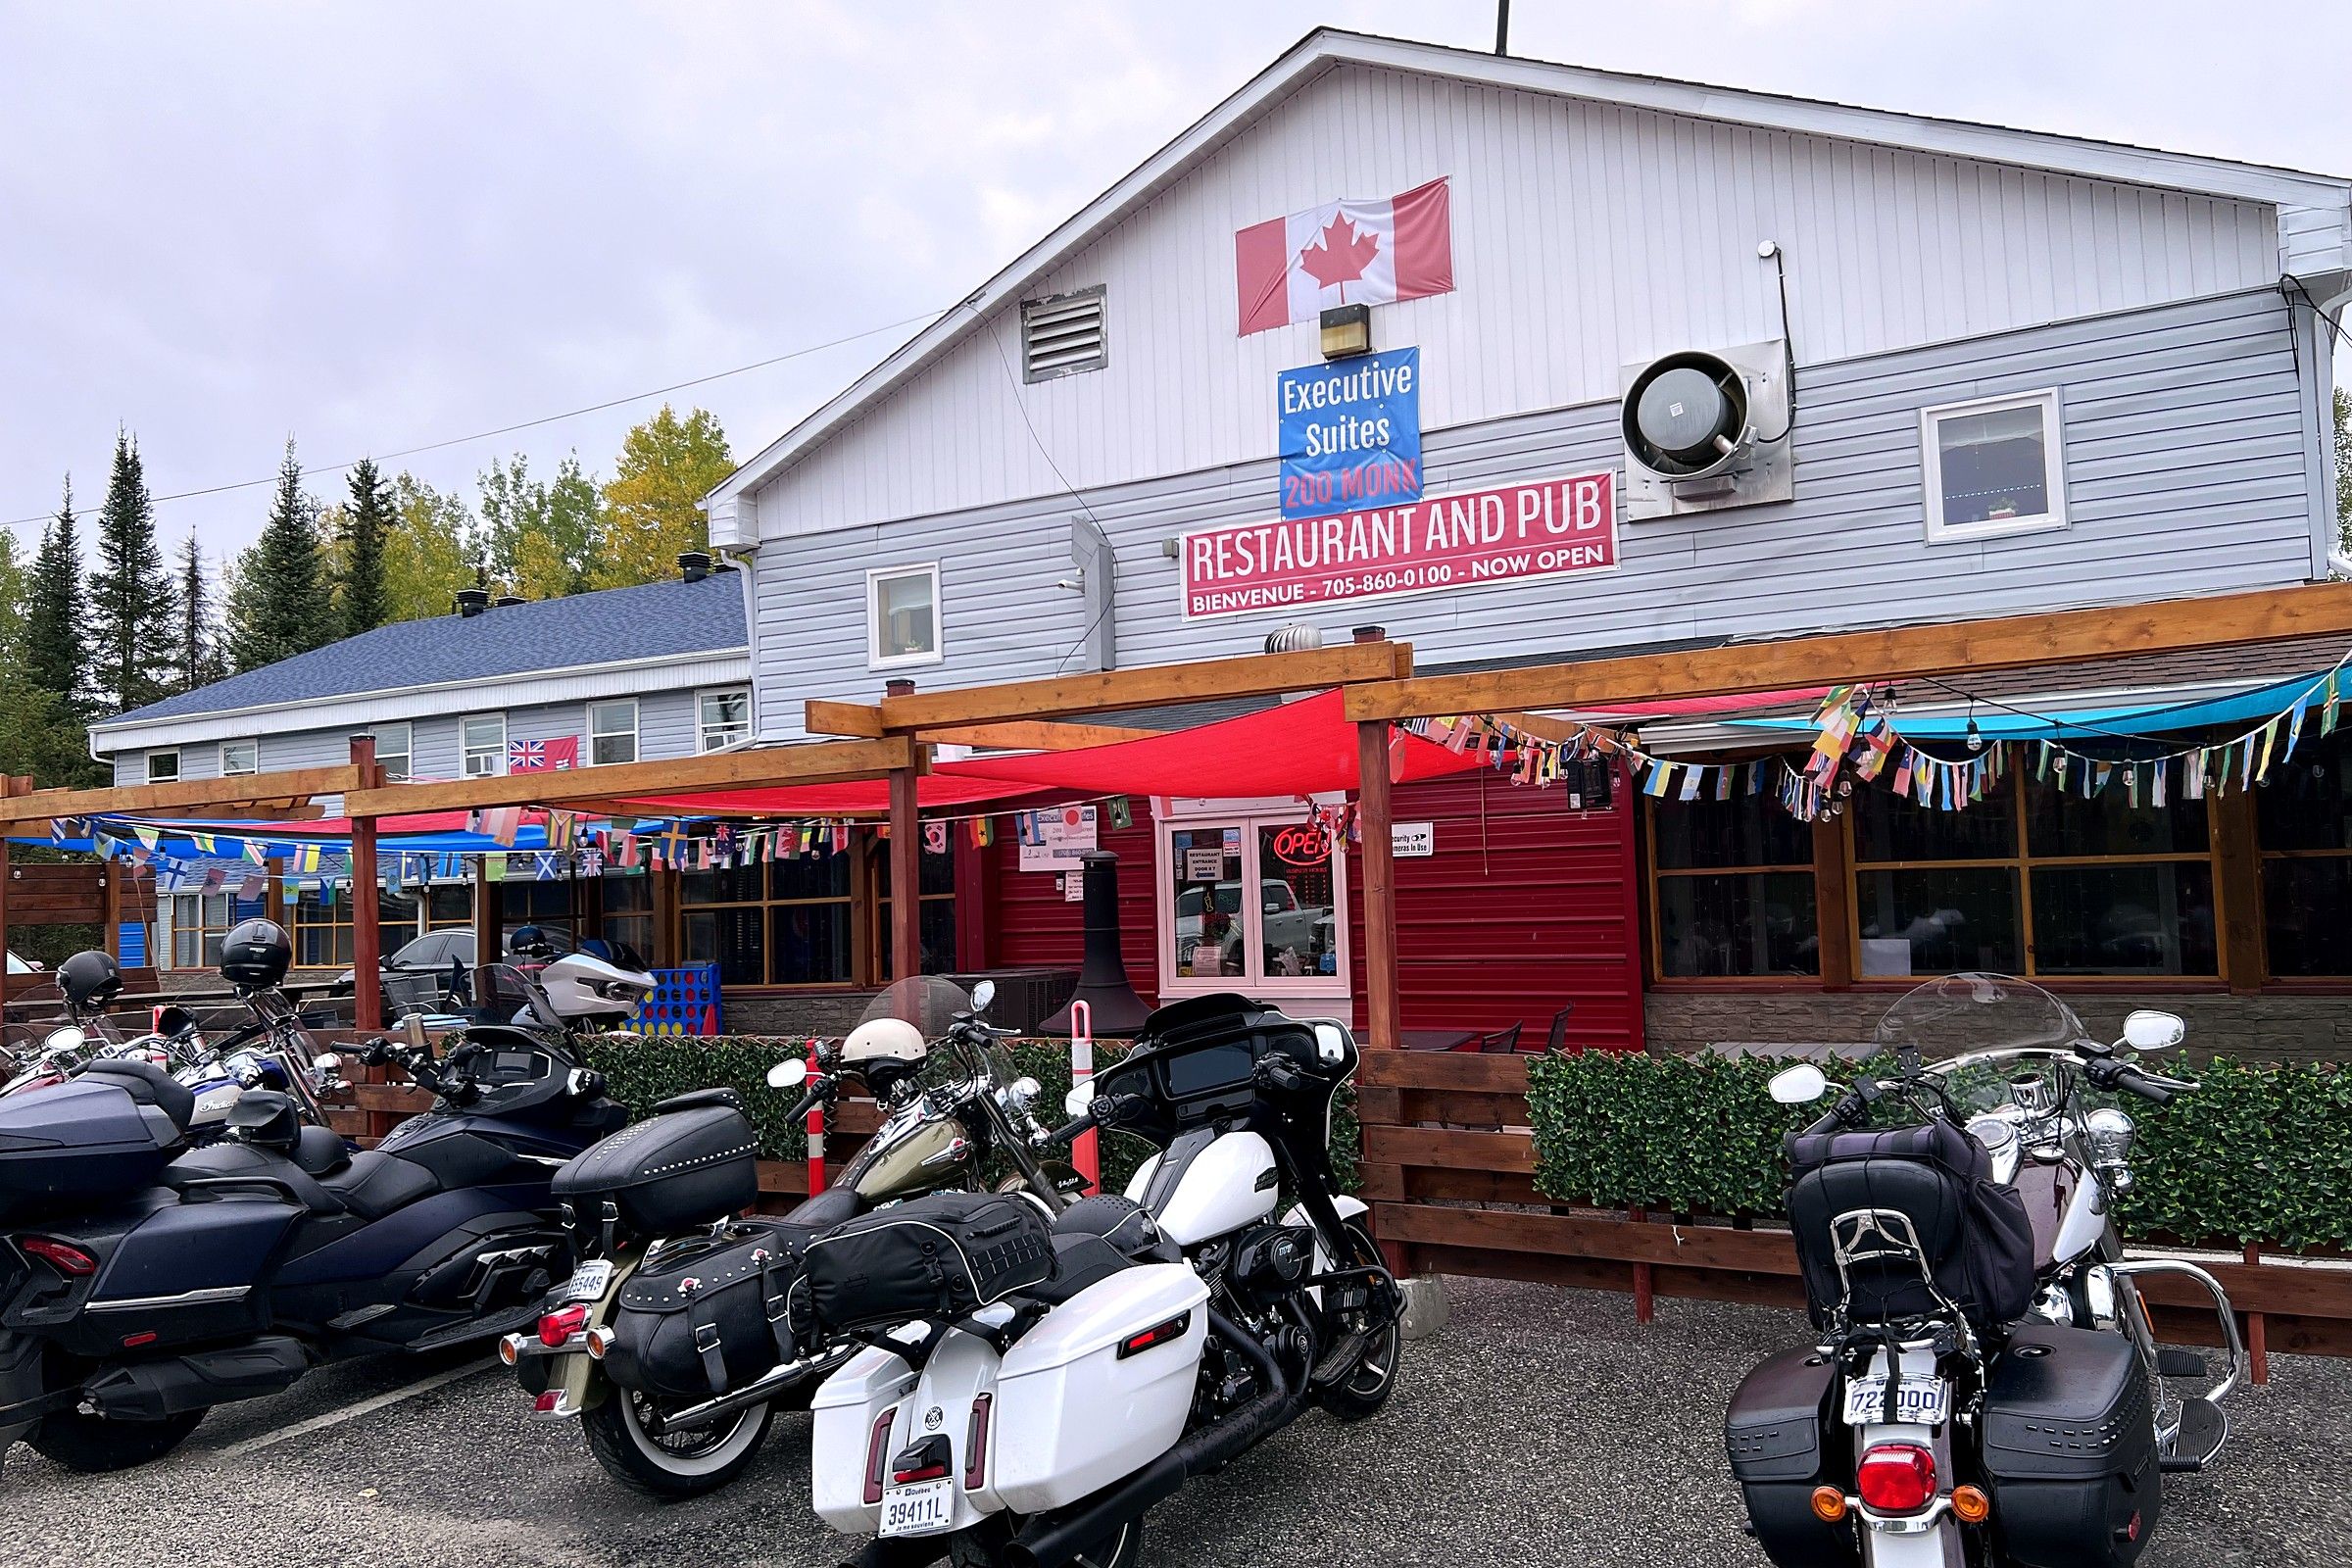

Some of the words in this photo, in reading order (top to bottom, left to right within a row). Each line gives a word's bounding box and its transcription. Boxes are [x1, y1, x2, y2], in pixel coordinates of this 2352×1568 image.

[1284, 361, 1411, 415] Executive
[1306, 415, 1390, 457] Suites
[1285, 470, 1333, 509] 200
[1342, 458, 1419, 502] MONK
[1194, 507, 1417, 582] RESTAURANT
[1425, 494, 1505, 551] AND
[1517, 480, 1601, 538] PUB
[1192, 583, 1304, 612] BIENVENUE
[1325, 564, 1452, 597] 705-860-0100
[1472, 554, 1531, 578] NOW
[1537, 544, 1604, 569] OPEN
[888, 1496, 943, 1526] 39411L
